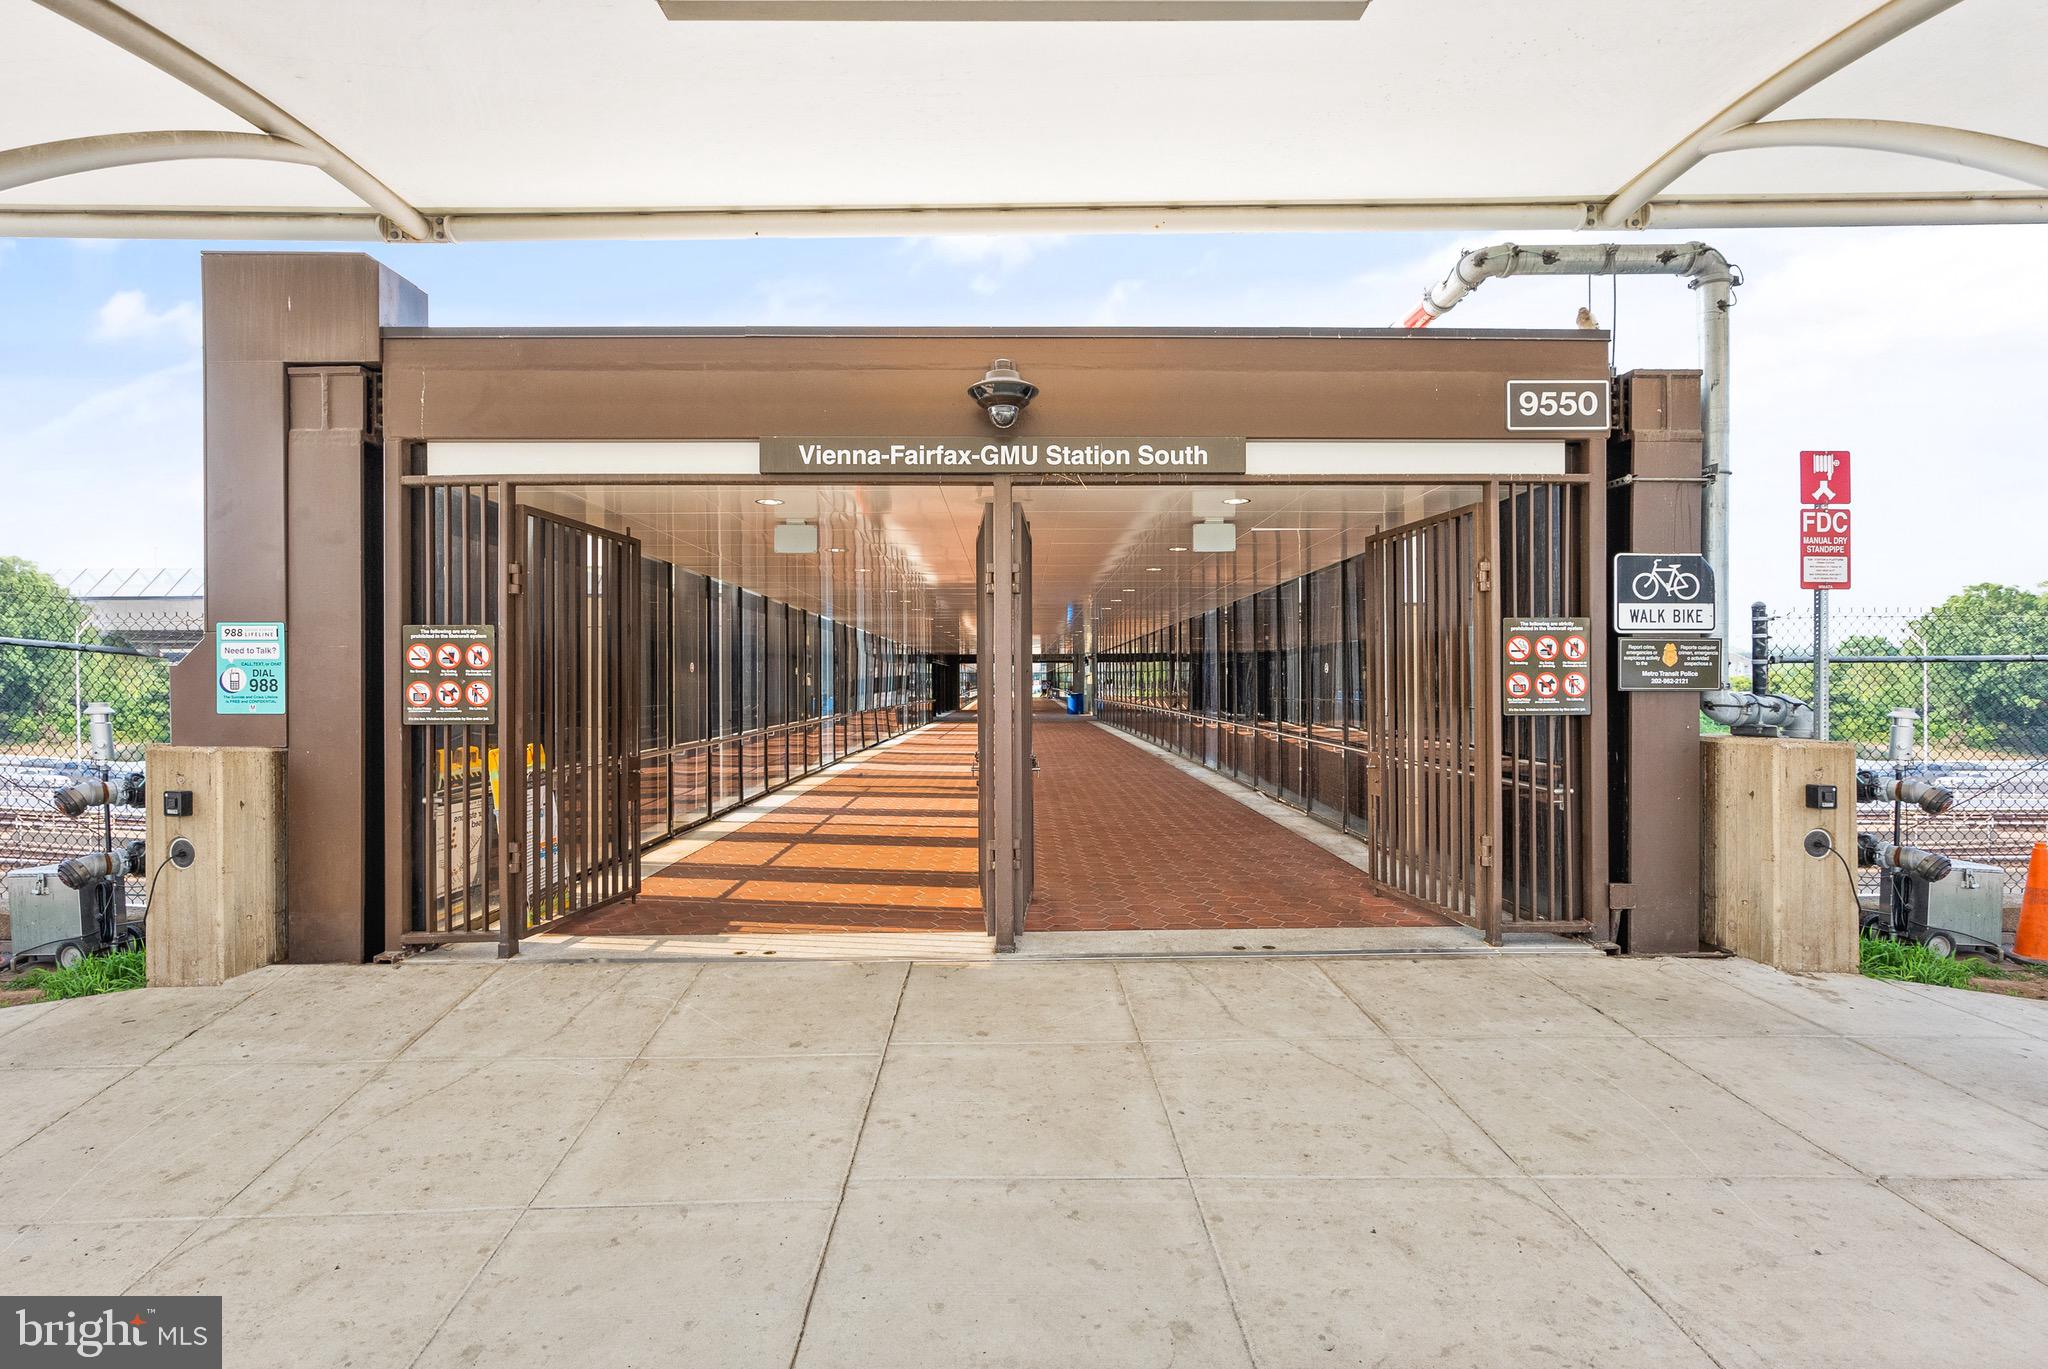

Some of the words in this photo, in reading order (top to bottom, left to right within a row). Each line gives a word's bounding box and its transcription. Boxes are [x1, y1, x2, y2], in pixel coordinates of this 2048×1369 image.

[1519, 391, 1598, 416] 9550
[799, 445, 1038, 466] Vienna-Fairfax-GMU
[1046, 445, 1130, 466] Station
[1138, 445, 1208, 466] South
[1802, 512, 1848, 533] FDC
[1804, 536, 1832, 544] MANUAL
[1833, 536, 1847, 544] DRY
[1630, 609, 1666, 623] WALK
[1673, 609, 1703, 623] BIKE
[224, 628, 243, 637] 988
[252, 669, 275, 677] DIAL
[249, 679, 278, 692] 988
